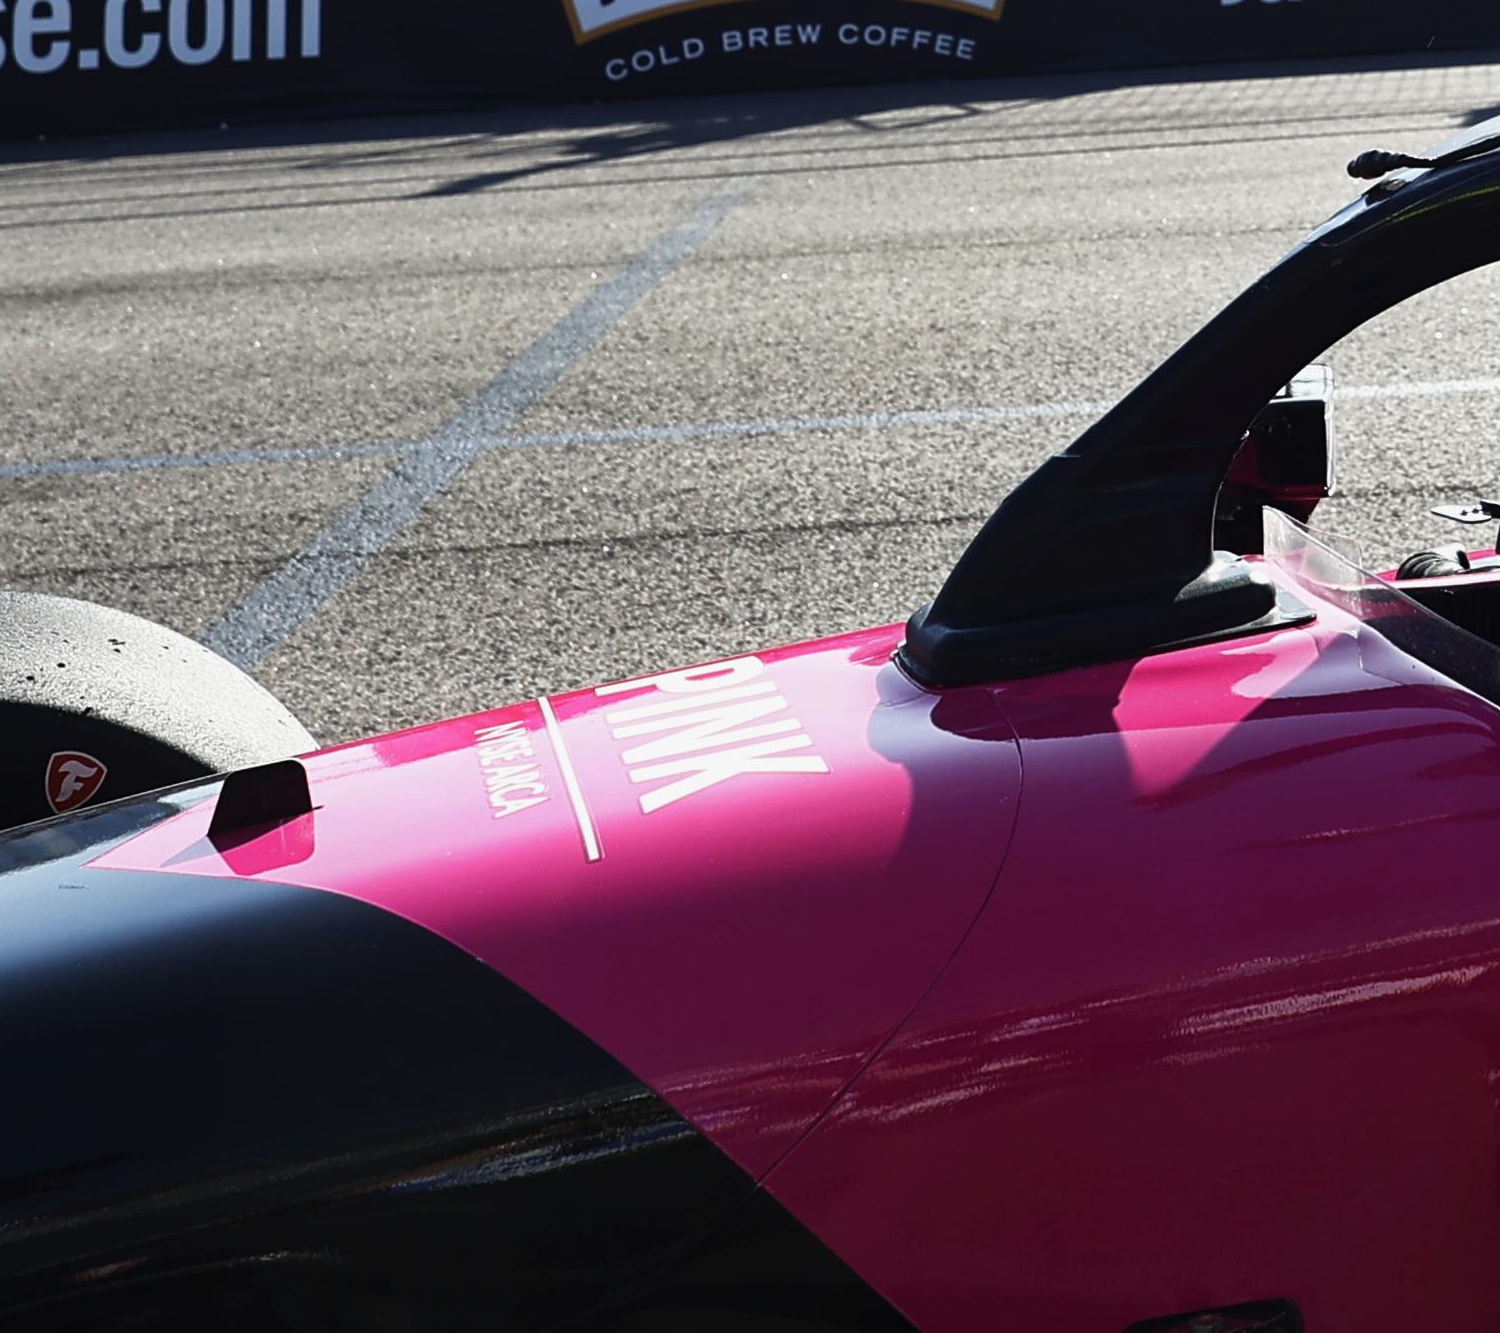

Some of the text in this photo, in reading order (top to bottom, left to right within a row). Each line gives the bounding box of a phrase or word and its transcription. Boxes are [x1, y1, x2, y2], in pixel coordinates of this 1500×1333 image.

[605, 23, 977, 81] COLD BREW COFFEE
[594, 655, 831, 815] PINK
[482, 762, 553, 820] ARCA
